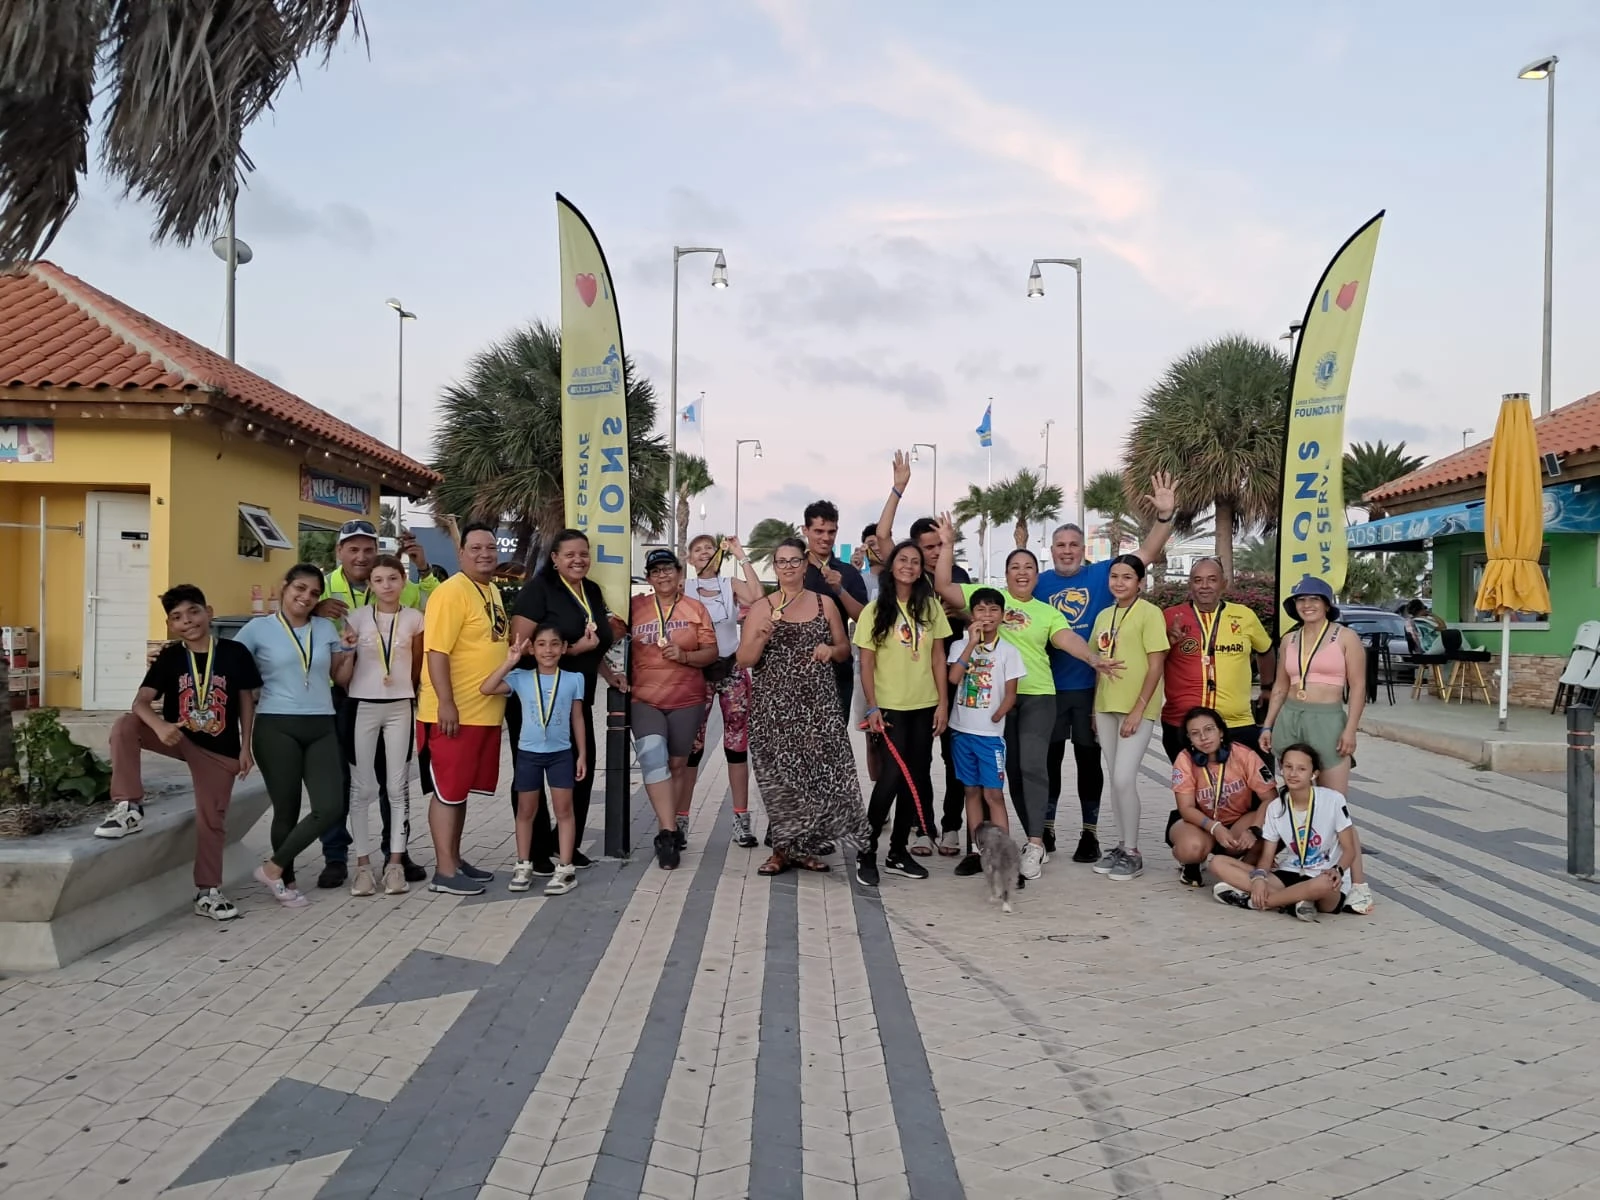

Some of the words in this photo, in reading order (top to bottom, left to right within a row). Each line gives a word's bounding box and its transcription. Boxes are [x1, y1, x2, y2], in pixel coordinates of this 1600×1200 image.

[311, 478, 335, 498] NICE
[337, 486, 363, 505] CREAM
[1291, 440, 1320, 594] IONS
[1317, 458, 1332, 533] SERV
